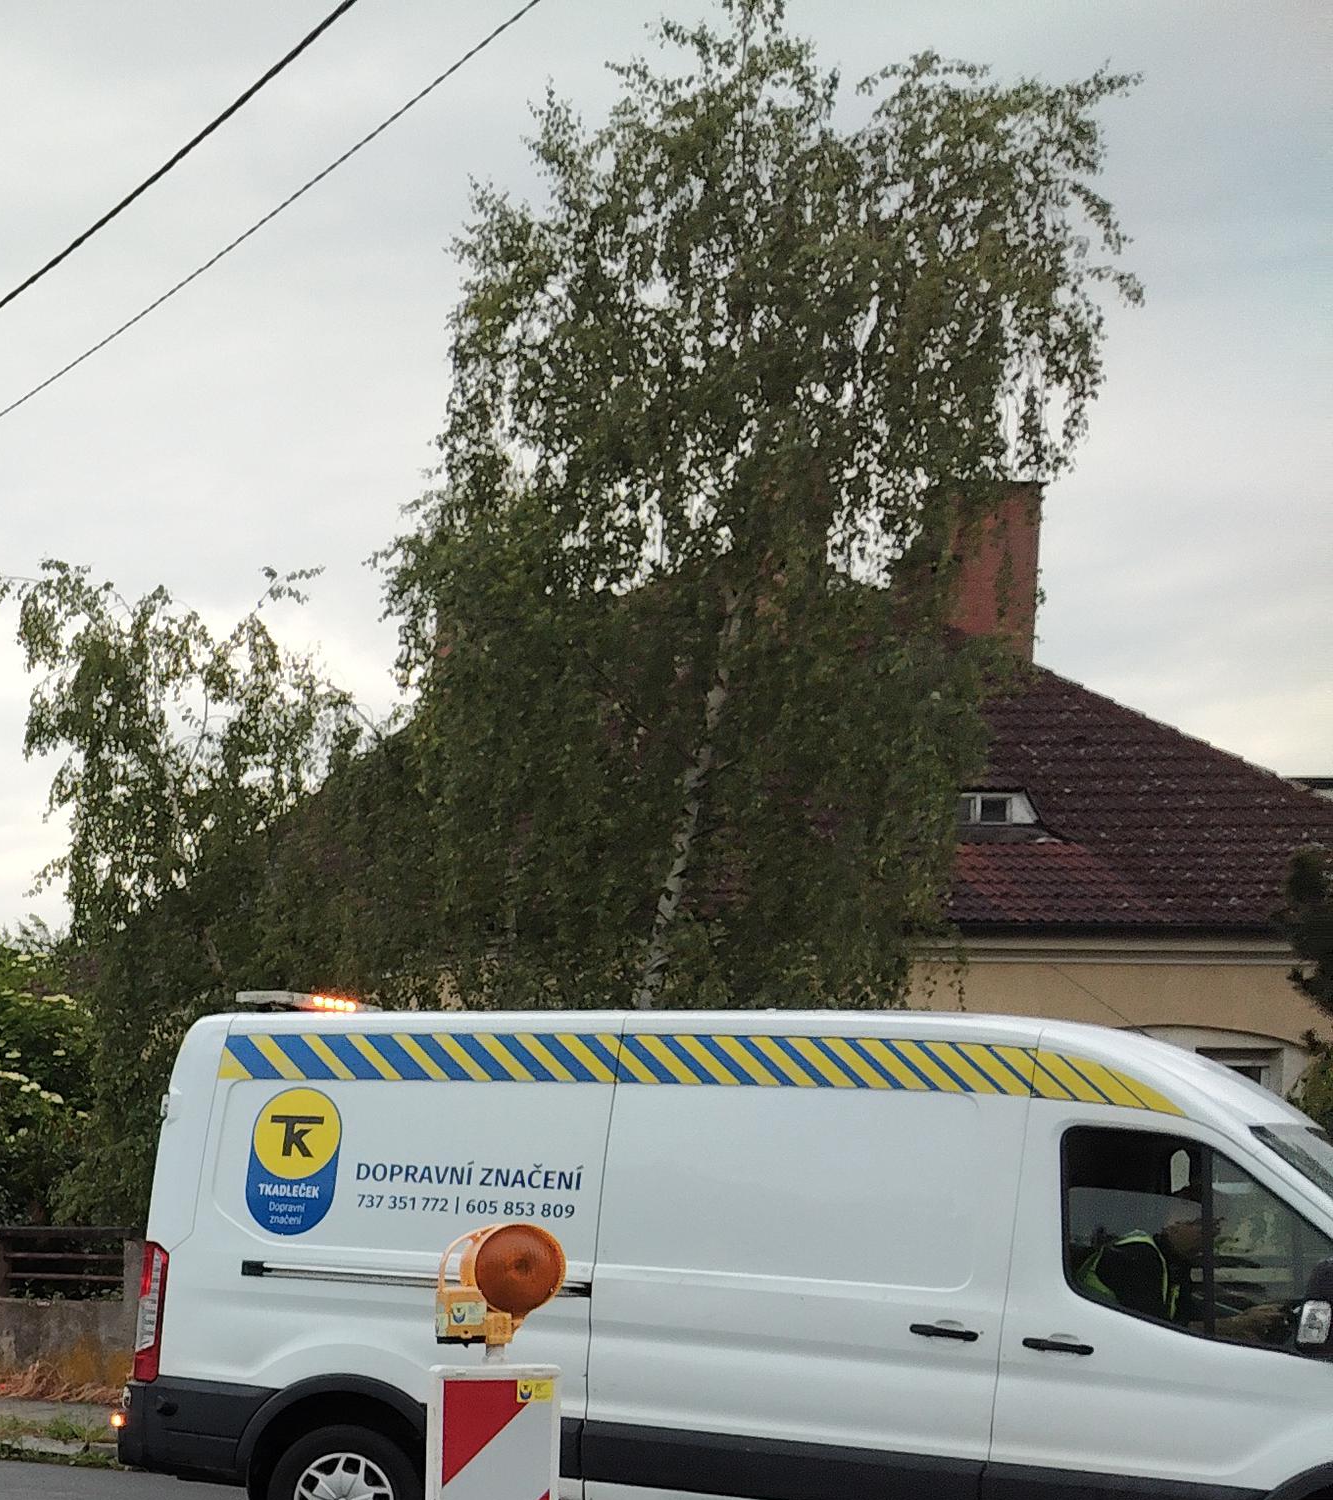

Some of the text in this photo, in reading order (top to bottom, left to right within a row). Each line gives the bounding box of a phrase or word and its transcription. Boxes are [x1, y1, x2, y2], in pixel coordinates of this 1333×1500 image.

[355, 1160, 584, 1191] DOPRAVNÍ ZNAČENÍ
[258, 1183, 320, 1198] TKADLEČEK
[268, 1201, 306, 1213] Dopravní
[357, 1194, 385, 1208] 737
[388, 1196, 416, 1210] 351
[421, 1197, 449, 1212] 772
[466, 1199, 499, 1214] 605
[503, 1201, 535, 1217] 853
[540, 1203, 575, 1219] 809
[269, 1214, 302, 1225] značení
